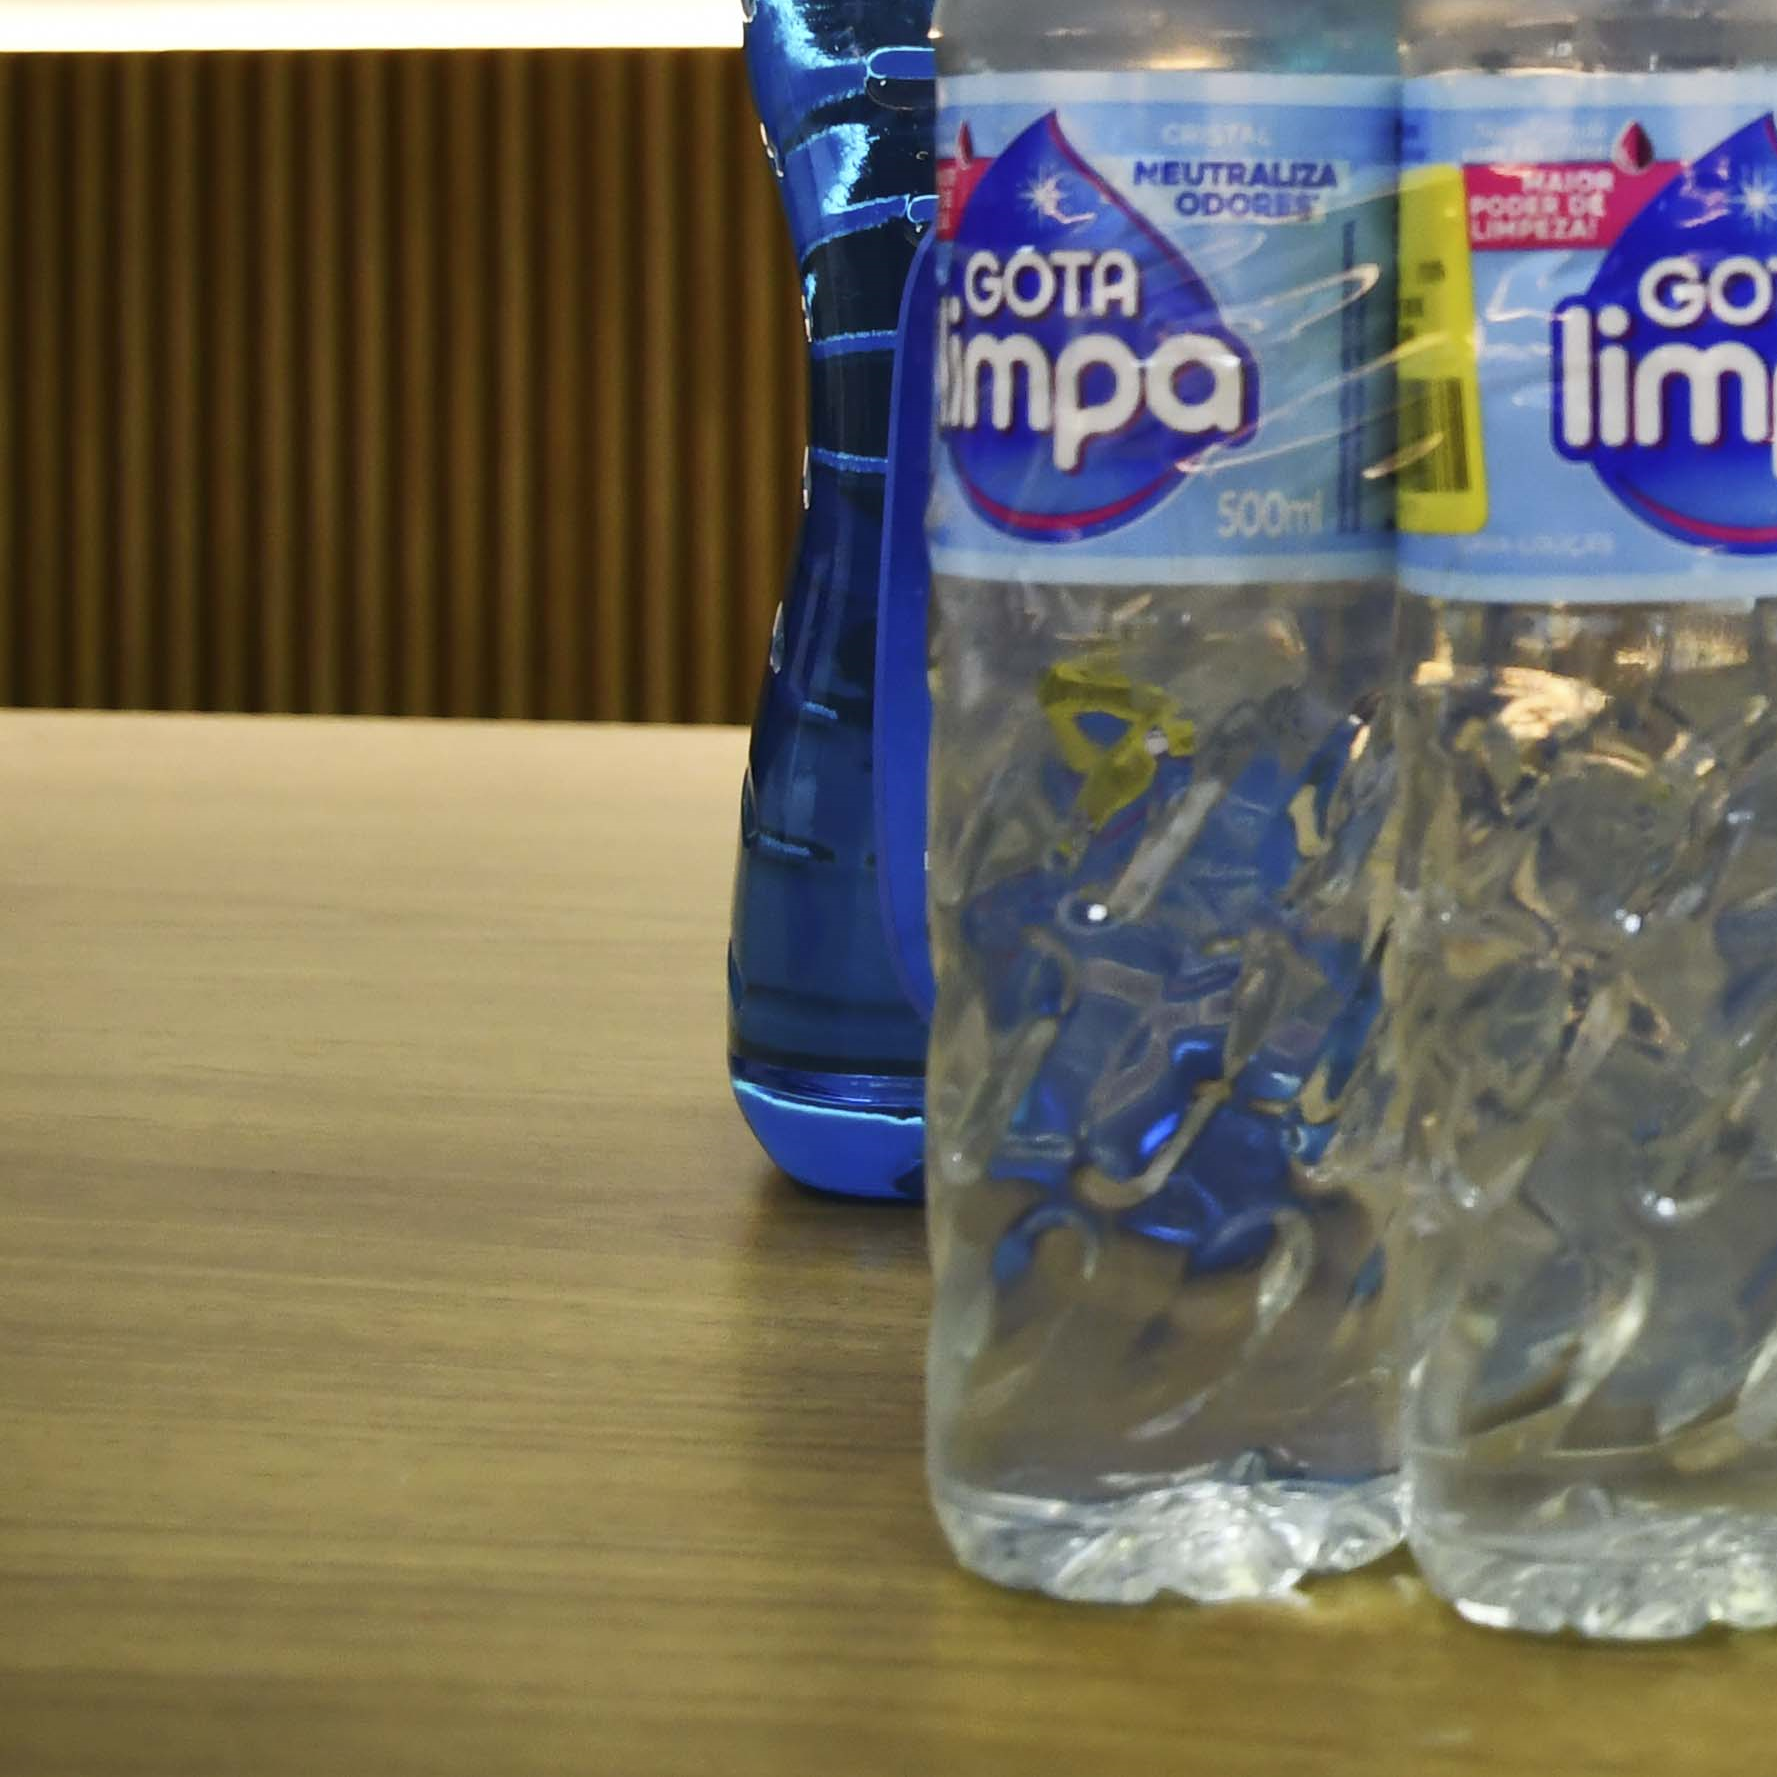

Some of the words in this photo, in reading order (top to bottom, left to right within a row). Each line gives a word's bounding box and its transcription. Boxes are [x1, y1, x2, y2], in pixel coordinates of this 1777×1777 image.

[1134, 160, 1337, 188] NEUTRALIZA
[1522, 172, 1614, 196] MAIOR
[1471, 196, 1562, 218] PODER
[1568, 193, 1604, 217] DE
[1471, 218, 1598, 241] LIMPEZA!
[964, 250, 1140, 318] GOTA
